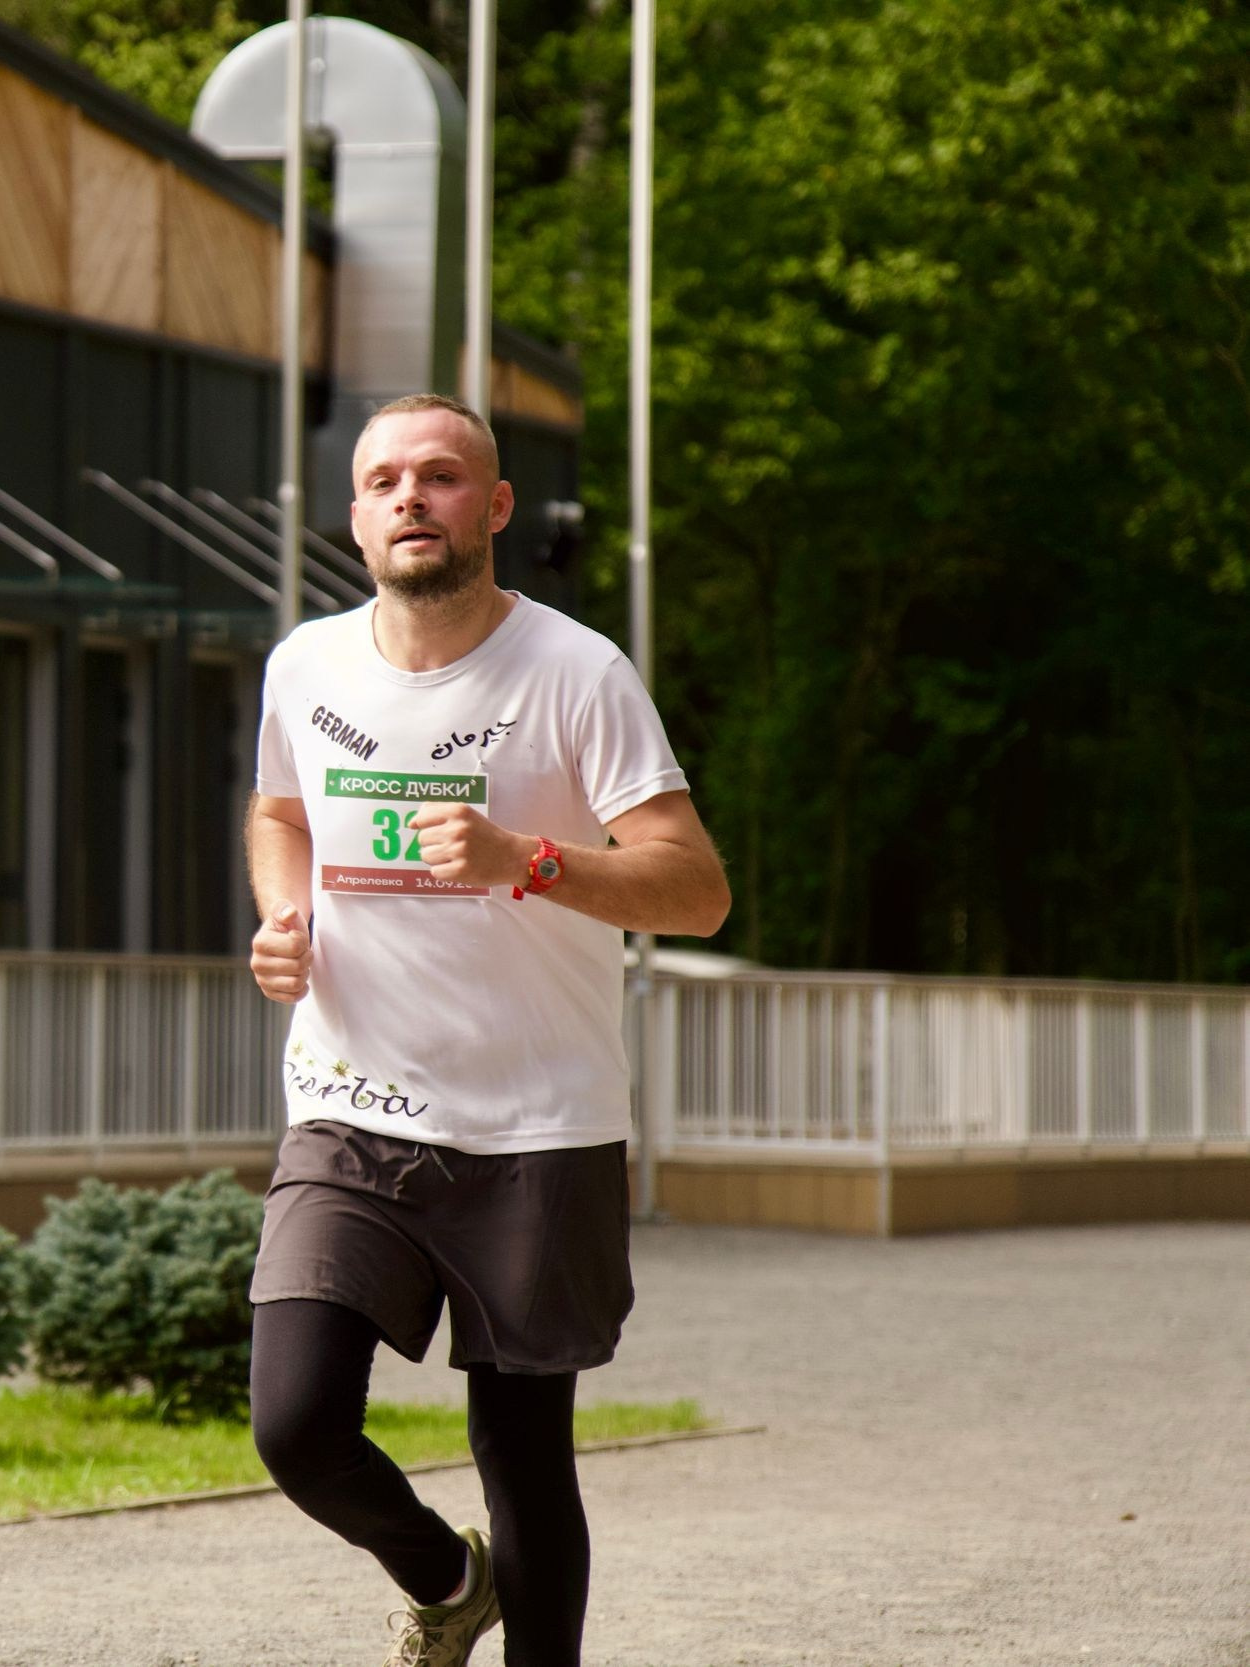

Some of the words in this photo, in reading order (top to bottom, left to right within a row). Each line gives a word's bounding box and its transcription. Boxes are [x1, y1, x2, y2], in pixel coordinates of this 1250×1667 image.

[311, 705, 380, 762] GERMAN
[431, 720, 518, 760] جيرمان
[340, 777, 402, 794] КРОСС
[405, 781, 470, 798] ДУБКИ
[336, 874, 404, 887] Апрелевка
